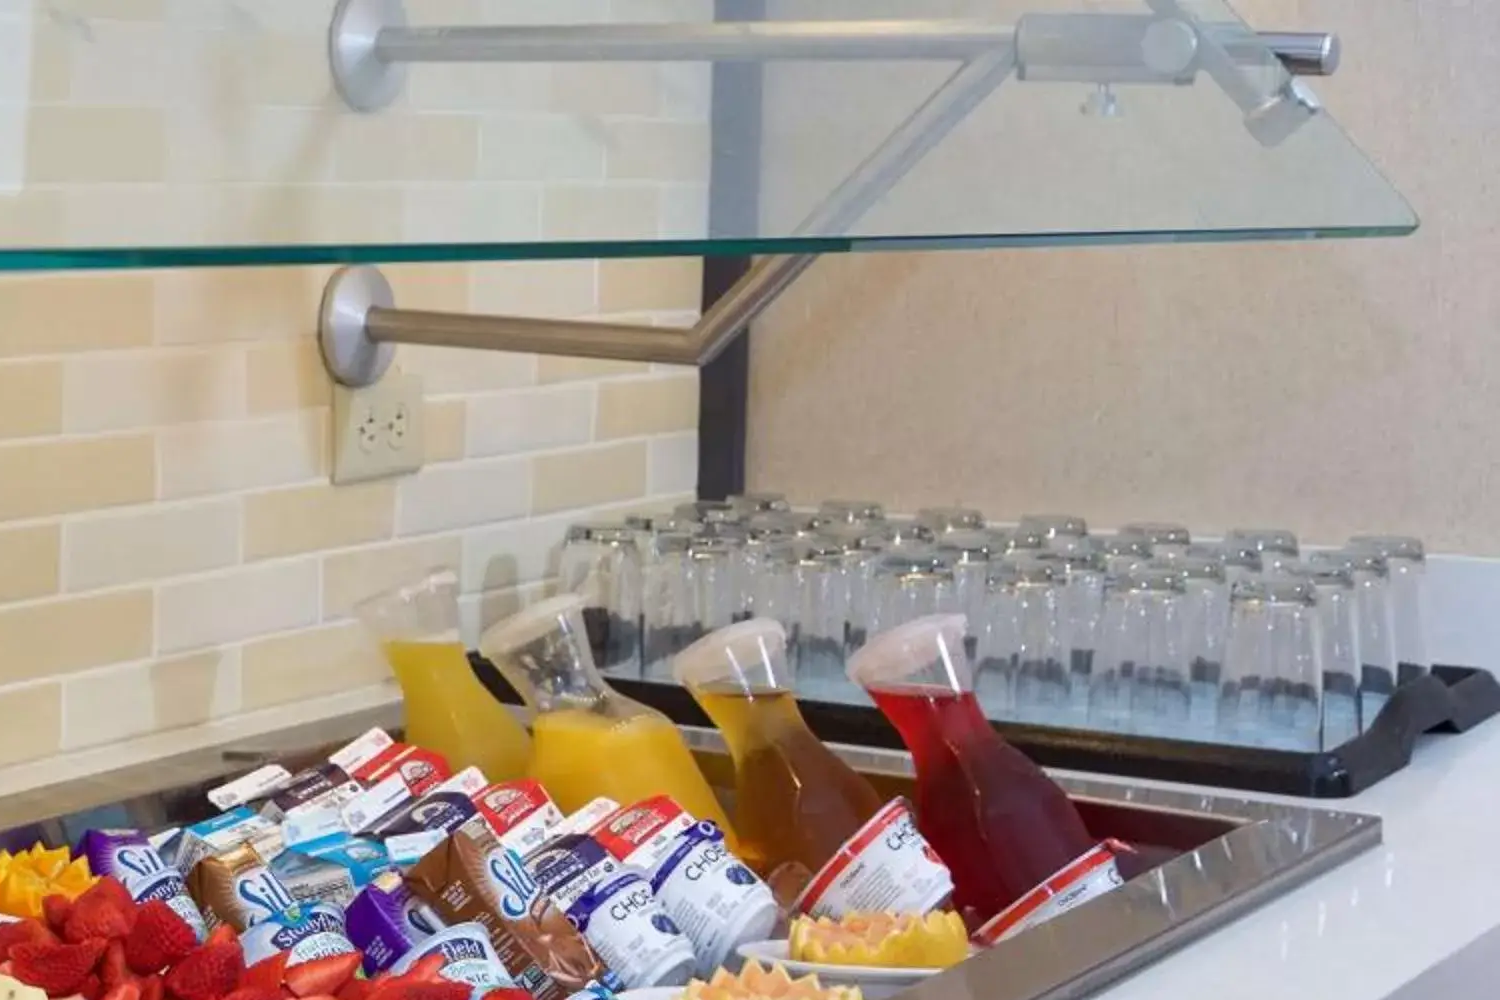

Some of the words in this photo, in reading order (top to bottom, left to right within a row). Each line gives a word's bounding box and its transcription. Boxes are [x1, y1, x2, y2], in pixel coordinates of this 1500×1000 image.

[117, 848, 161, 883] Sil
[490, 850, 537, 917] Sil
[238, 871, 294, 925] Sil
